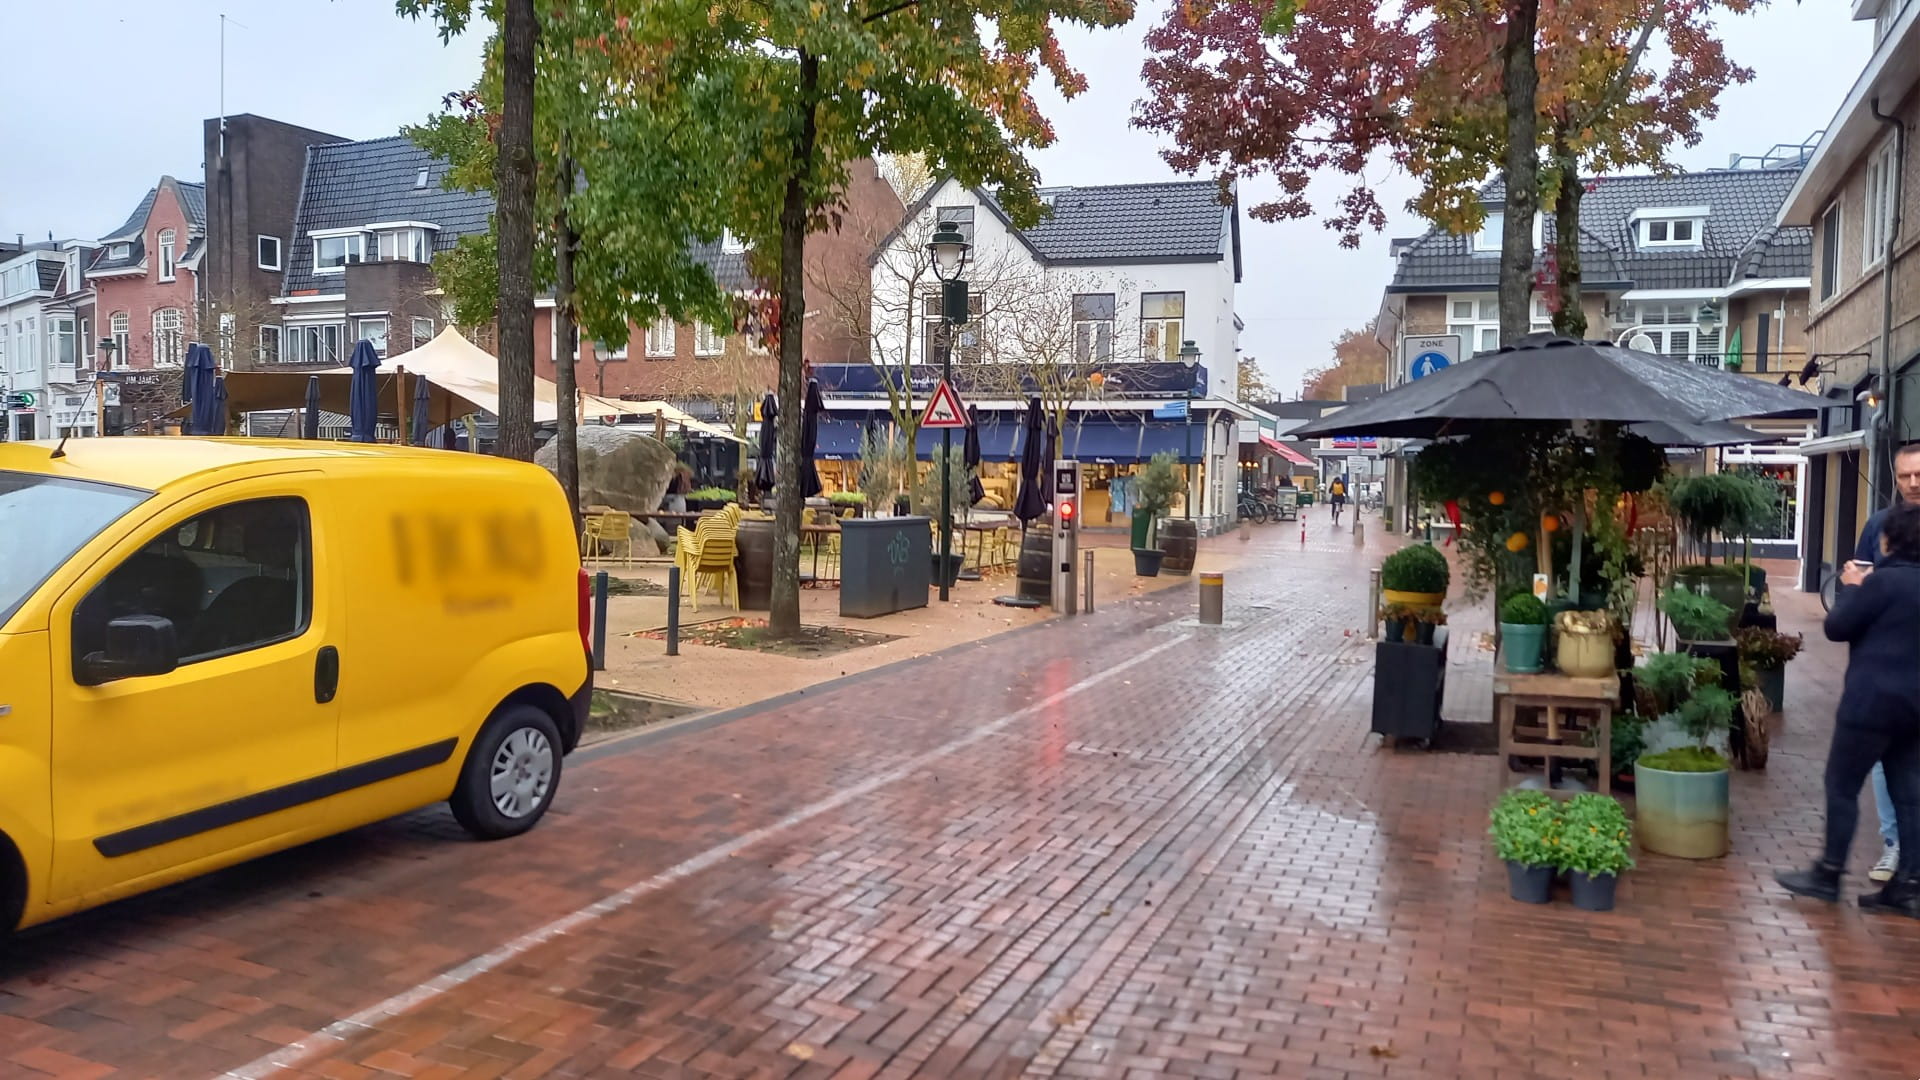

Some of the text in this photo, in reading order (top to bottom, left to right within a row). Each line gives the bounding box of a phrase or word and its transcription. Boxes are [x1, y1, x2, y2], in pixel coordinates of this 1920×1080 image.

[1419, 340, 1444, 348] ZONE
[125, 375, 160, 385] JIM JAMES
